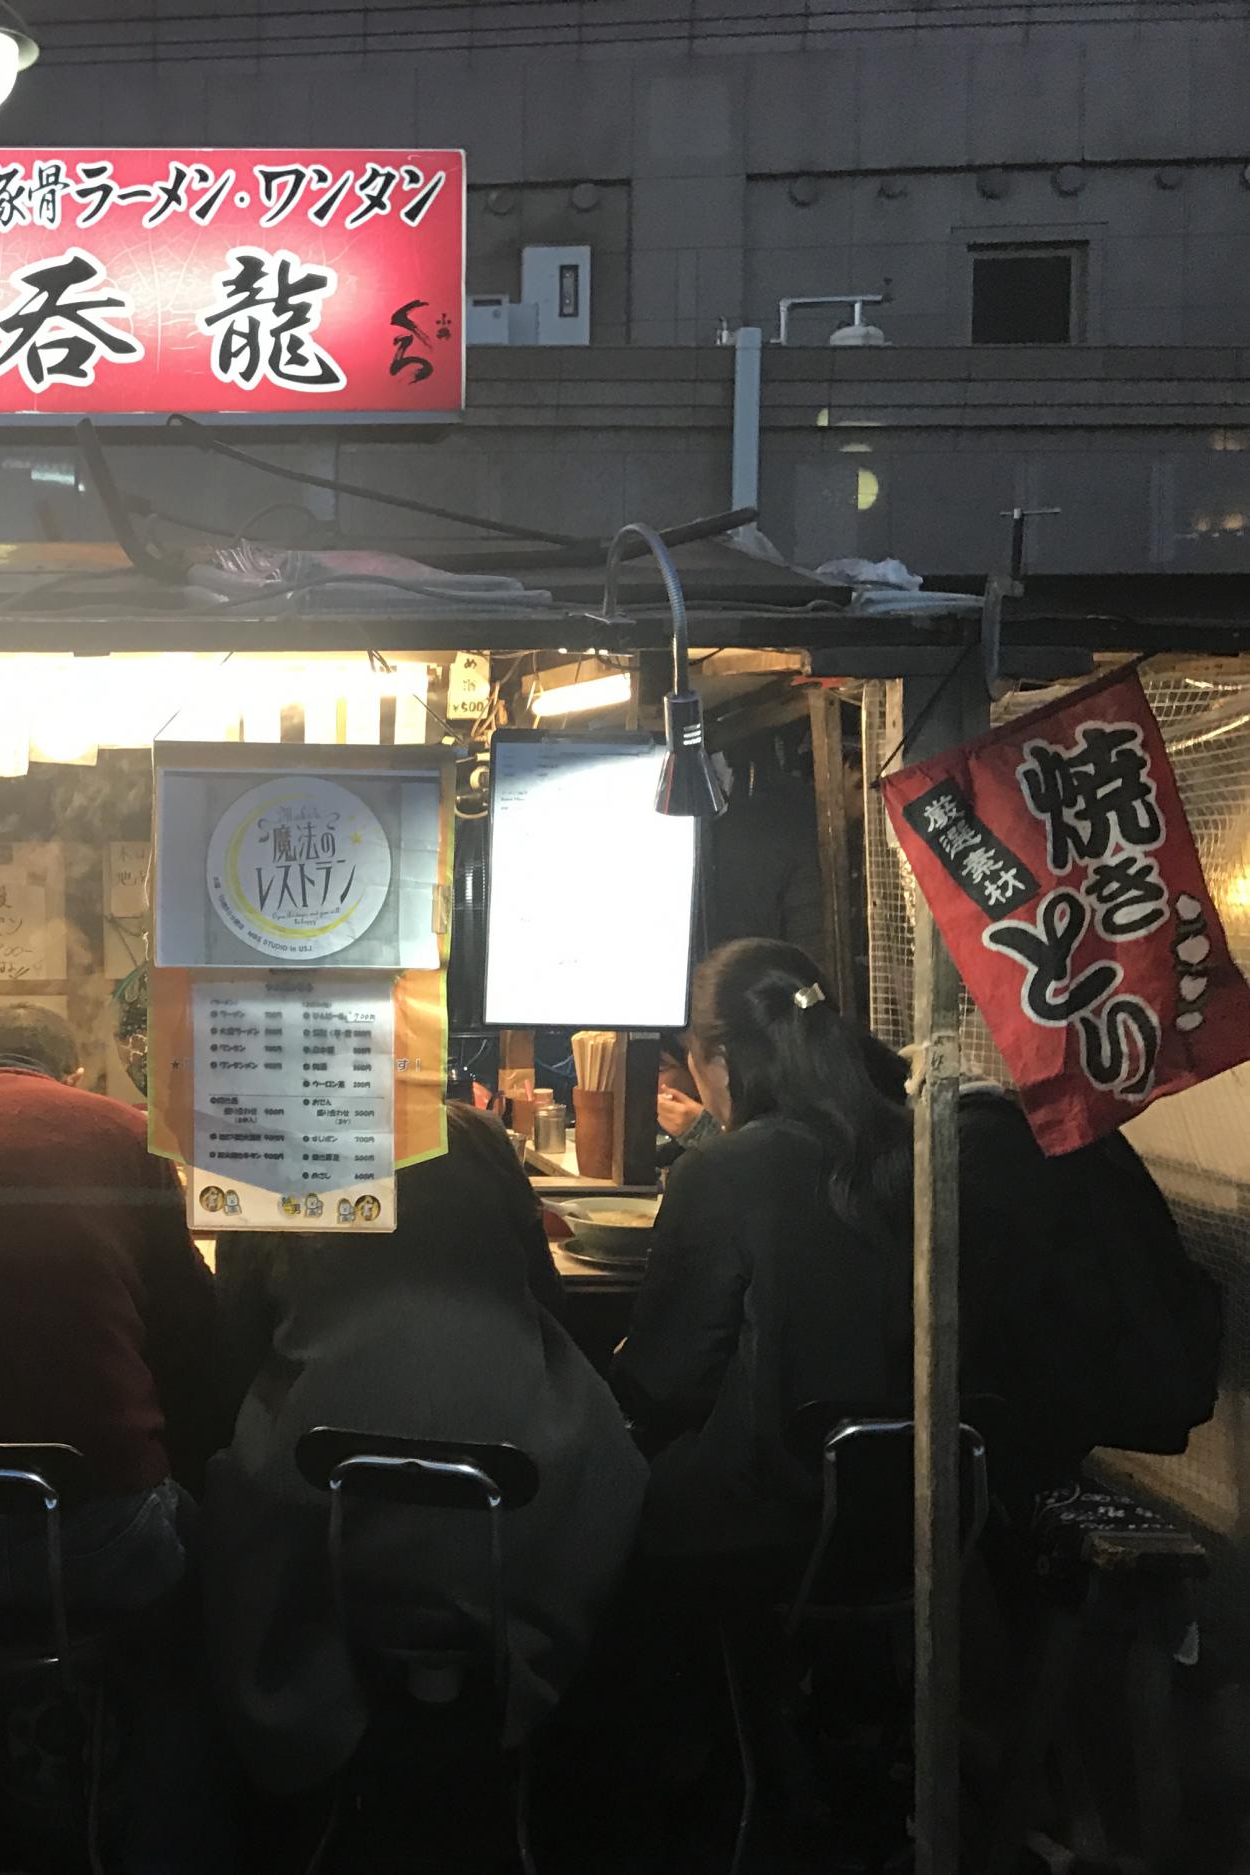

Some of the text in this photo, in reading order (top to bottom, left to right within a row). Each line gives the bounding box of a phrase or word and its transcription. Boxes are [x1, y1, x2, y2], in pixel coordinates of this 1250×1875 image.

[271, 822, 338, 864] 魔法の
[256, 859, 357, 912] レストラン
[984, 722, 1168, 1101] 焼きとり
